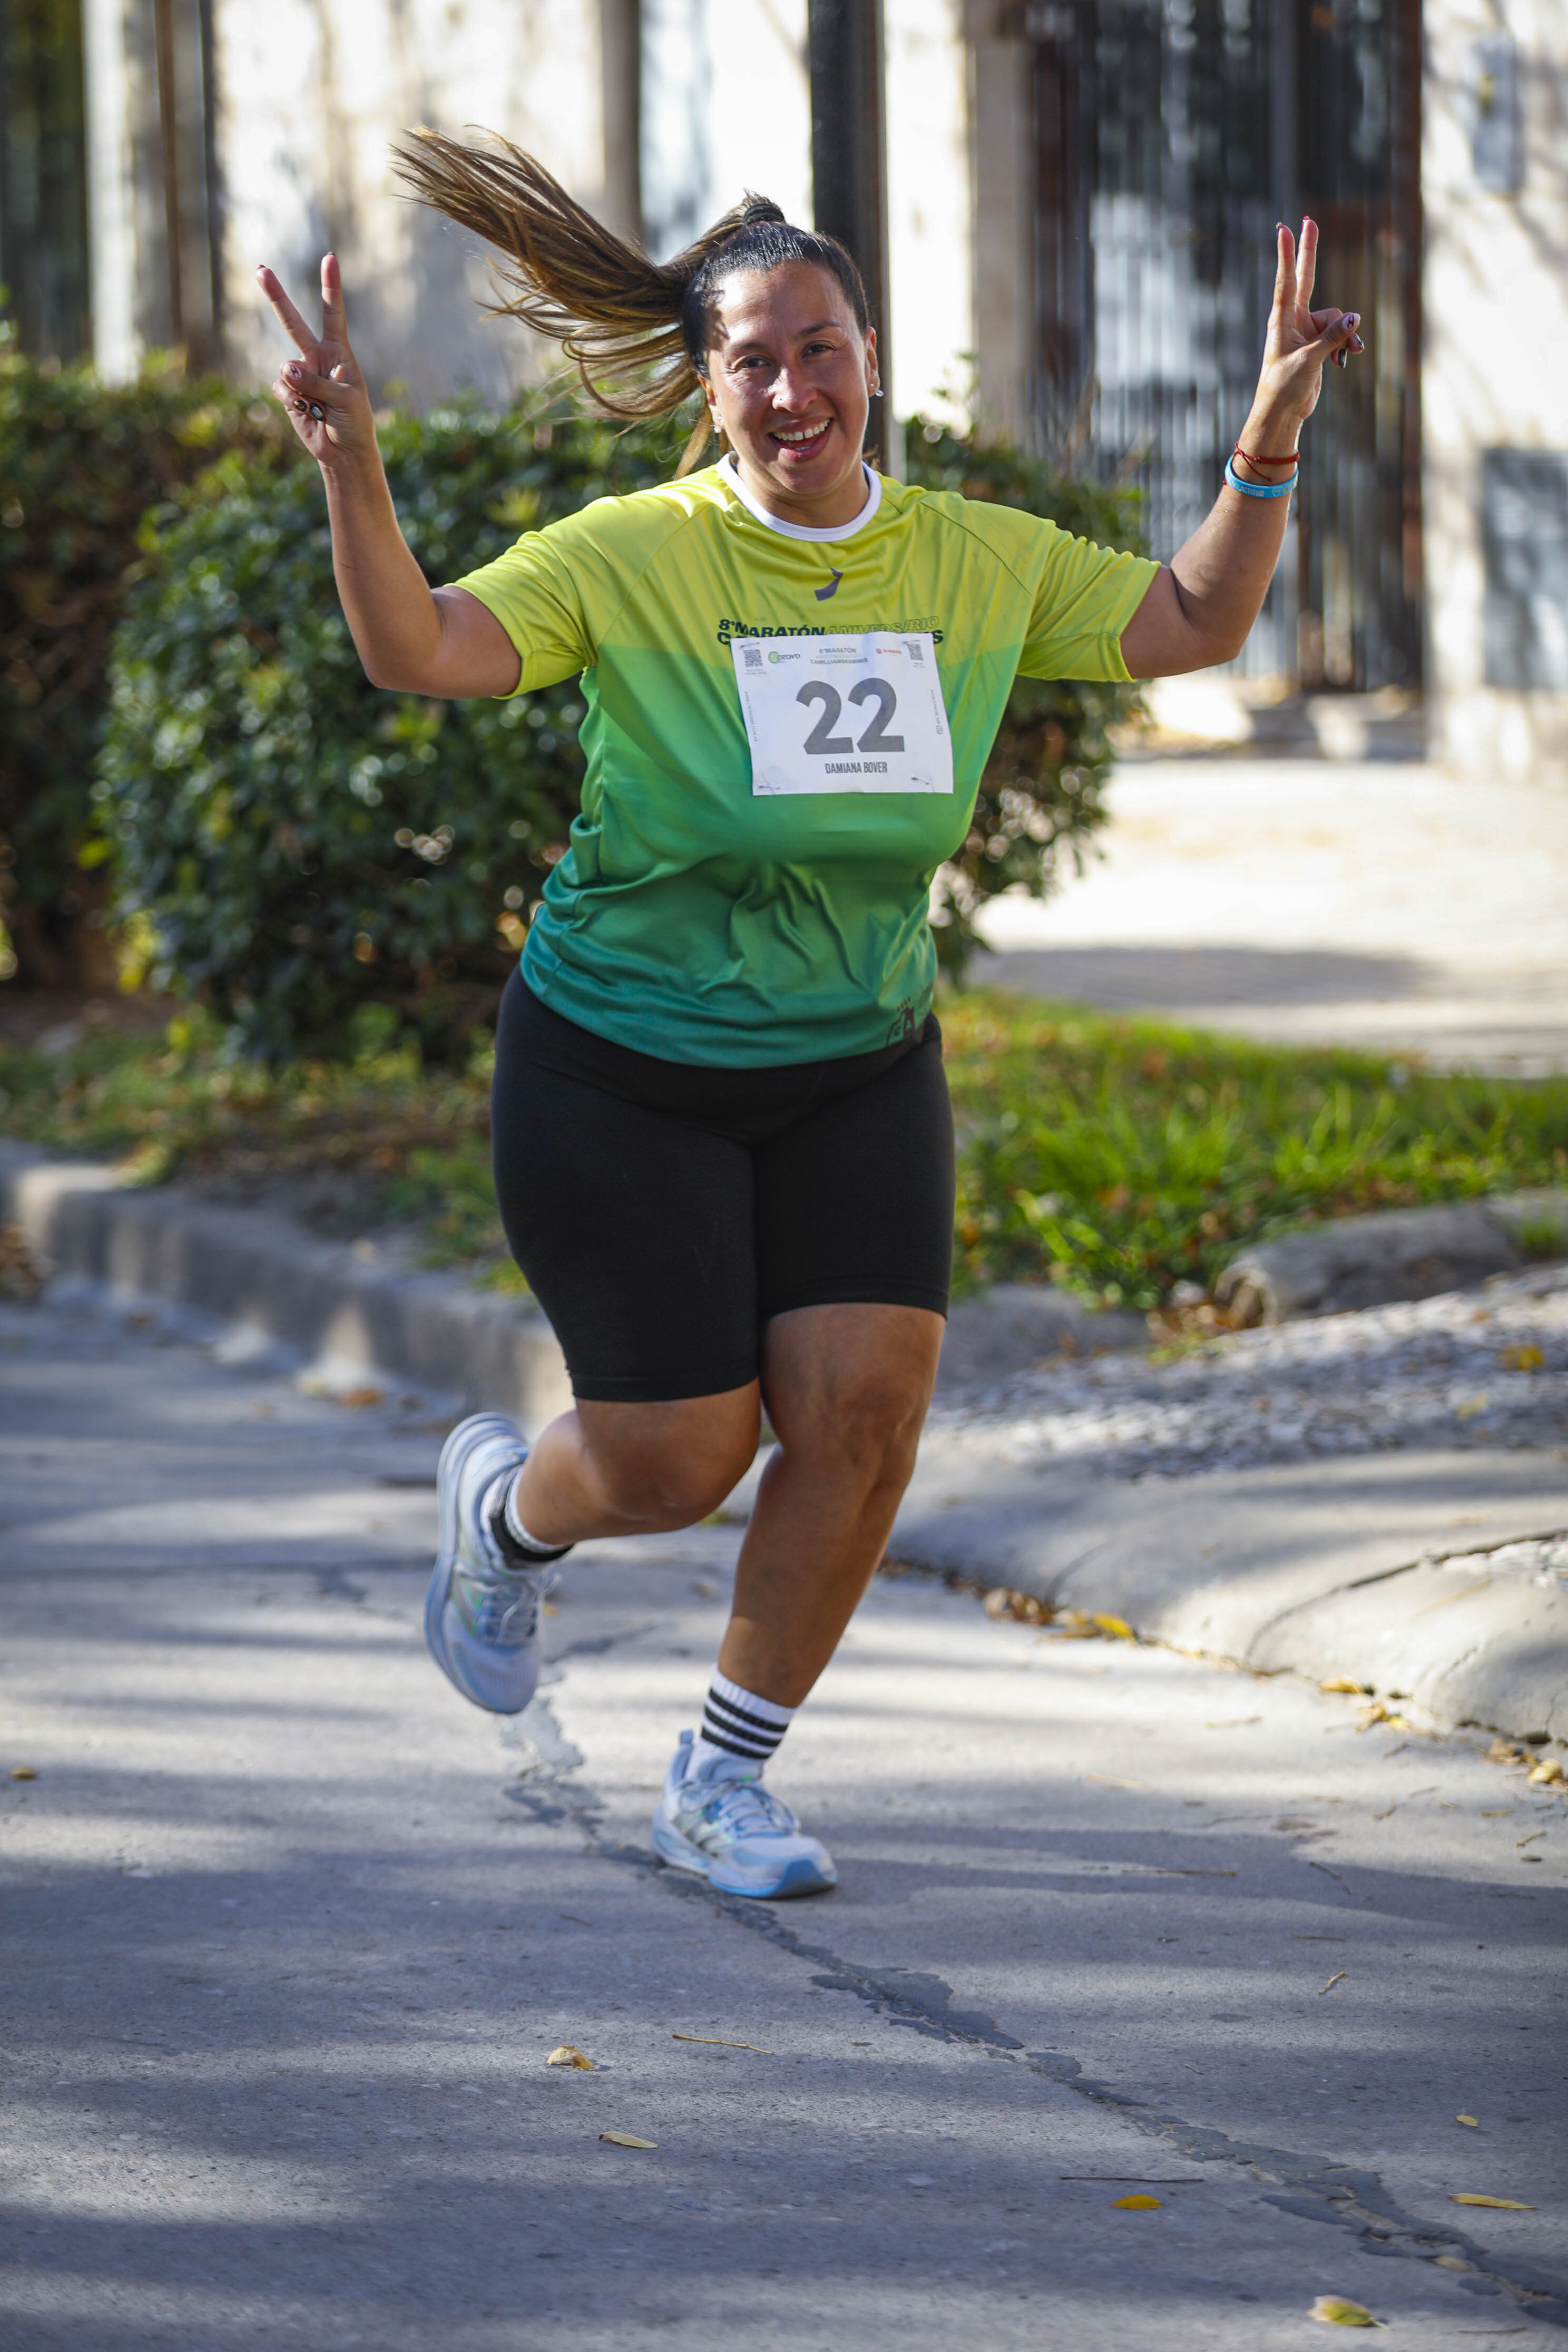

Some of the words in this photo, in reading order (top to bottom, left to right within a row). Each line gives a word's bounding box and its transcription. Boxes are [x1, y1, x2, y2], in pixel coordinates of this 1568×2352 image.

[796, 678, 905, 754] 22
[825, 762, 862, 773] DAMIANA
[863, 761, 888, 773] BOVER
